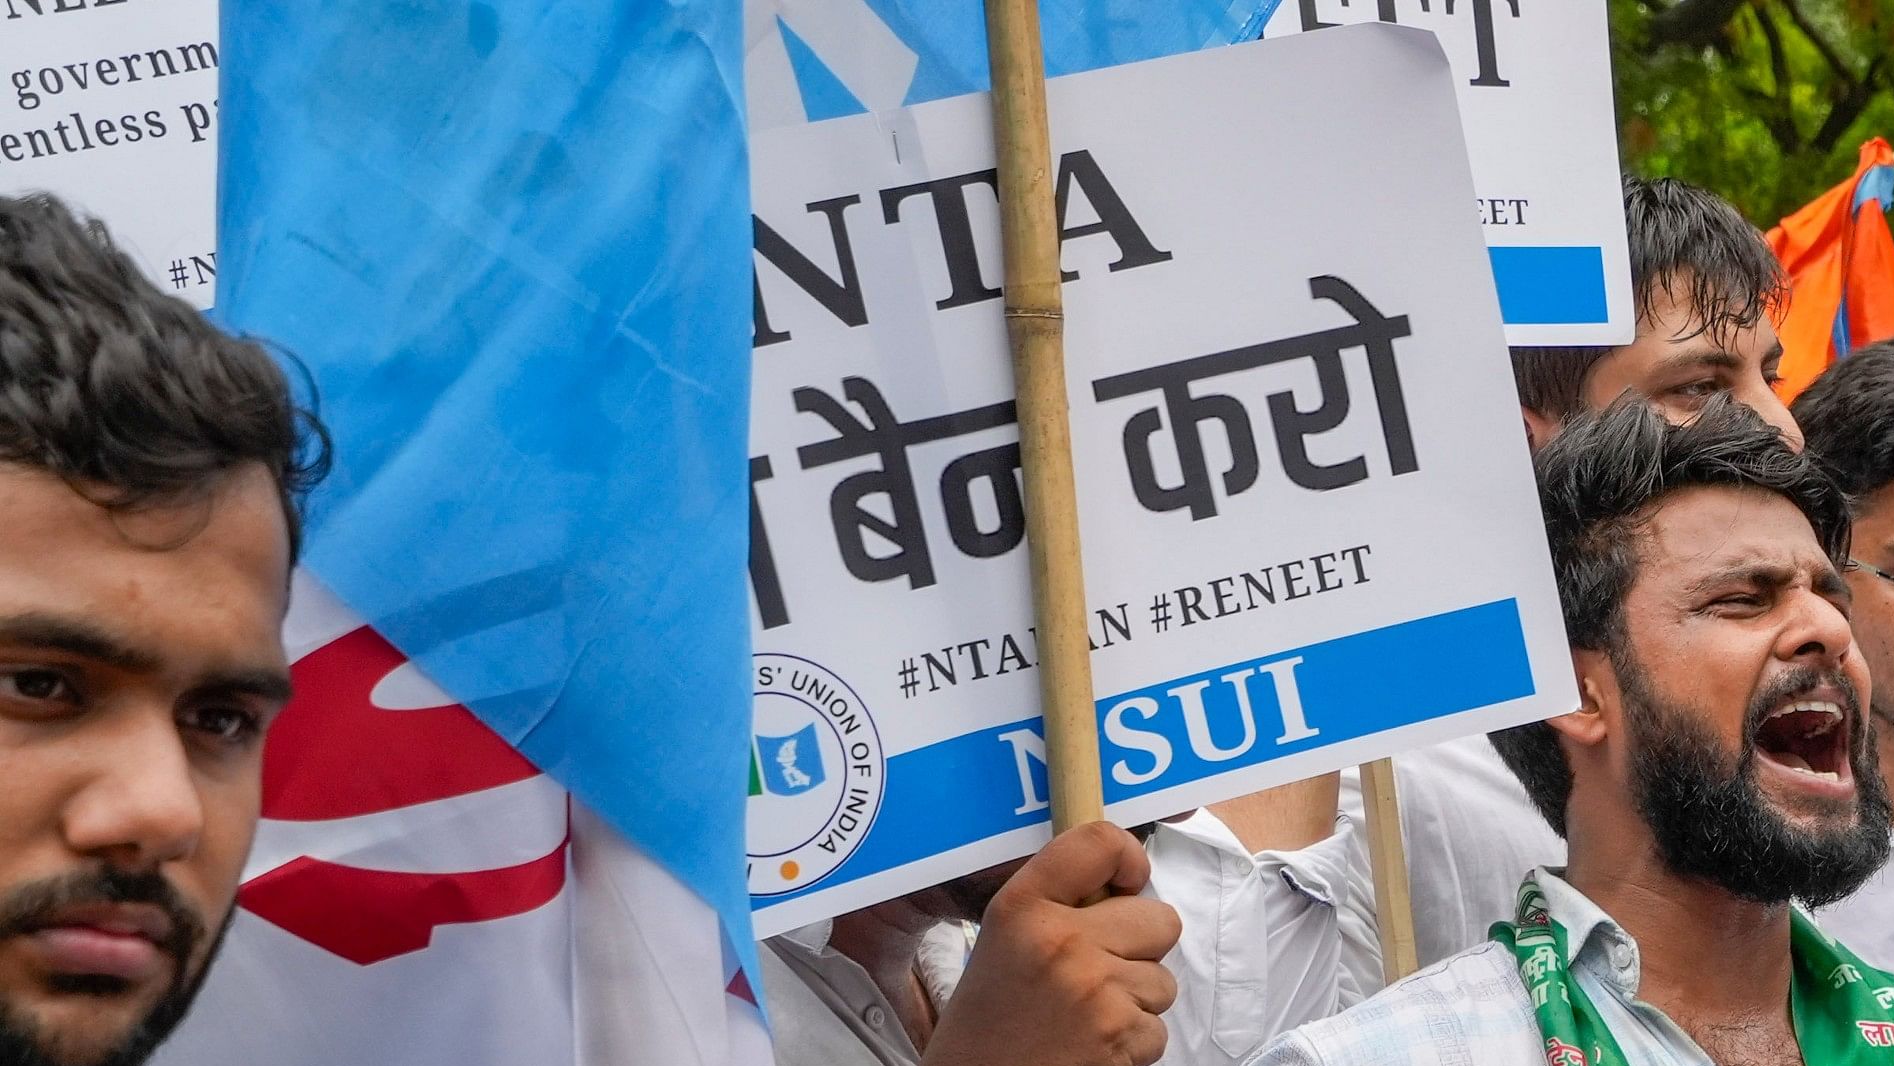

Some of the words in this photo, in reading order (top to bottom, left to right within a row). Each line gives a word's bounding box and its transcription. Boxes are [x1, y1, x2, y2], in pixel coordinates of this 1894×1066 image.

[752, 149, 1173, 348] NTA
[1092, 274, 1420, 521] करो
[898, 603, 1132, 698] #NTAN
[1150, 544, 1372, 633] #RENEET
[791, 671, 861, 734] UNION
[851, 743, 871, 777] OF
[818, 789, 869, 854] INDIA
